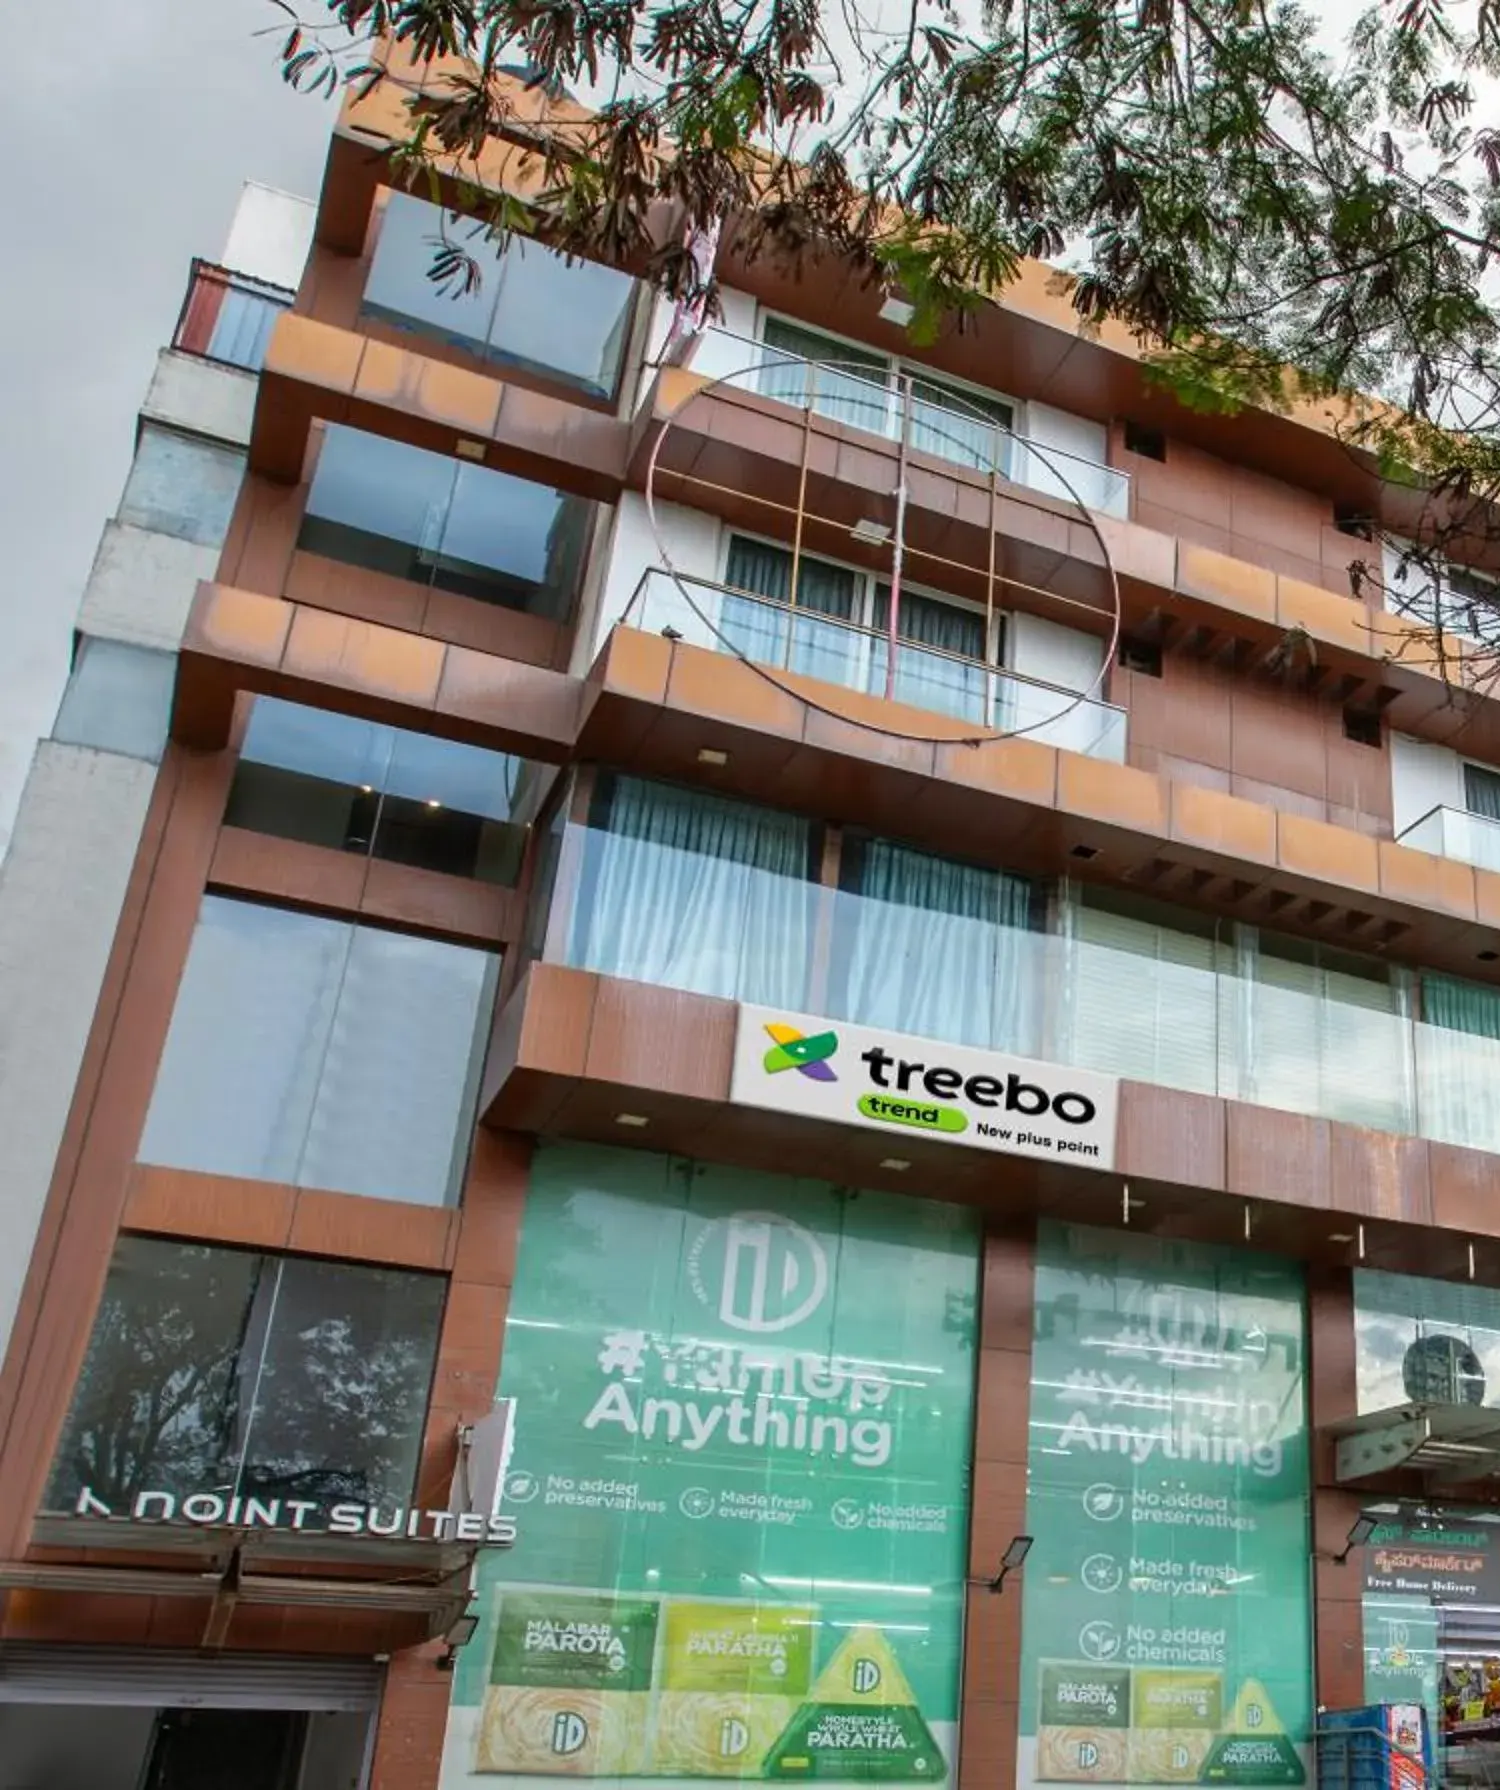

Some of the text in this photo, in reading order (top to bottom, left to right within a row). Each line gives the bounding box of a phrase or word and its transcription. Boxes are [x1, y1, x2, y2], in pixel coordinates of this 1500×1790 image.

[861, 1046, 1097, 1125] treebo
[868, 1097, 939, 1124] trend
[976, 1122, 1100, 1157] New plus point
[584, 1382, 892, 1466] Anything
[1057, 1410, 1283, 1476] Anything
[547, 1473, 639, 1497] No added
[544, 1489, 668, 1514] preservatives
[720, 1489, 814, 1511] Made fresh
[867, 1501, 948, 1520] No added
[1132, 1489, 1228, 1512] No added
[328, 1502, 518, 1542] SUITES
[719, 1504, 797, 1526] everyday
[867, 1515, 949, 1533] chemicals
[1131, 1506, 1257, 1532] preservatives
[1129, 1556, 1239, 1580] Made fresh
[1128, 1577, 1220, 1597] everyday
[1367, 1575, 1393, 1588] Free
[1431, 1580, 1478, 1596] Delivery
[527, 1619, 612, 1636] MALABAR
[1126, 1624, 1227, 1645] No added
[524, 1631, 626, 1656] PAROTA
[687, 1638, 788, 1657] PARATHA
[1126, 1641, 1227, 1663] chemicals
[807, 1731, 908, 1748] PARATHA
